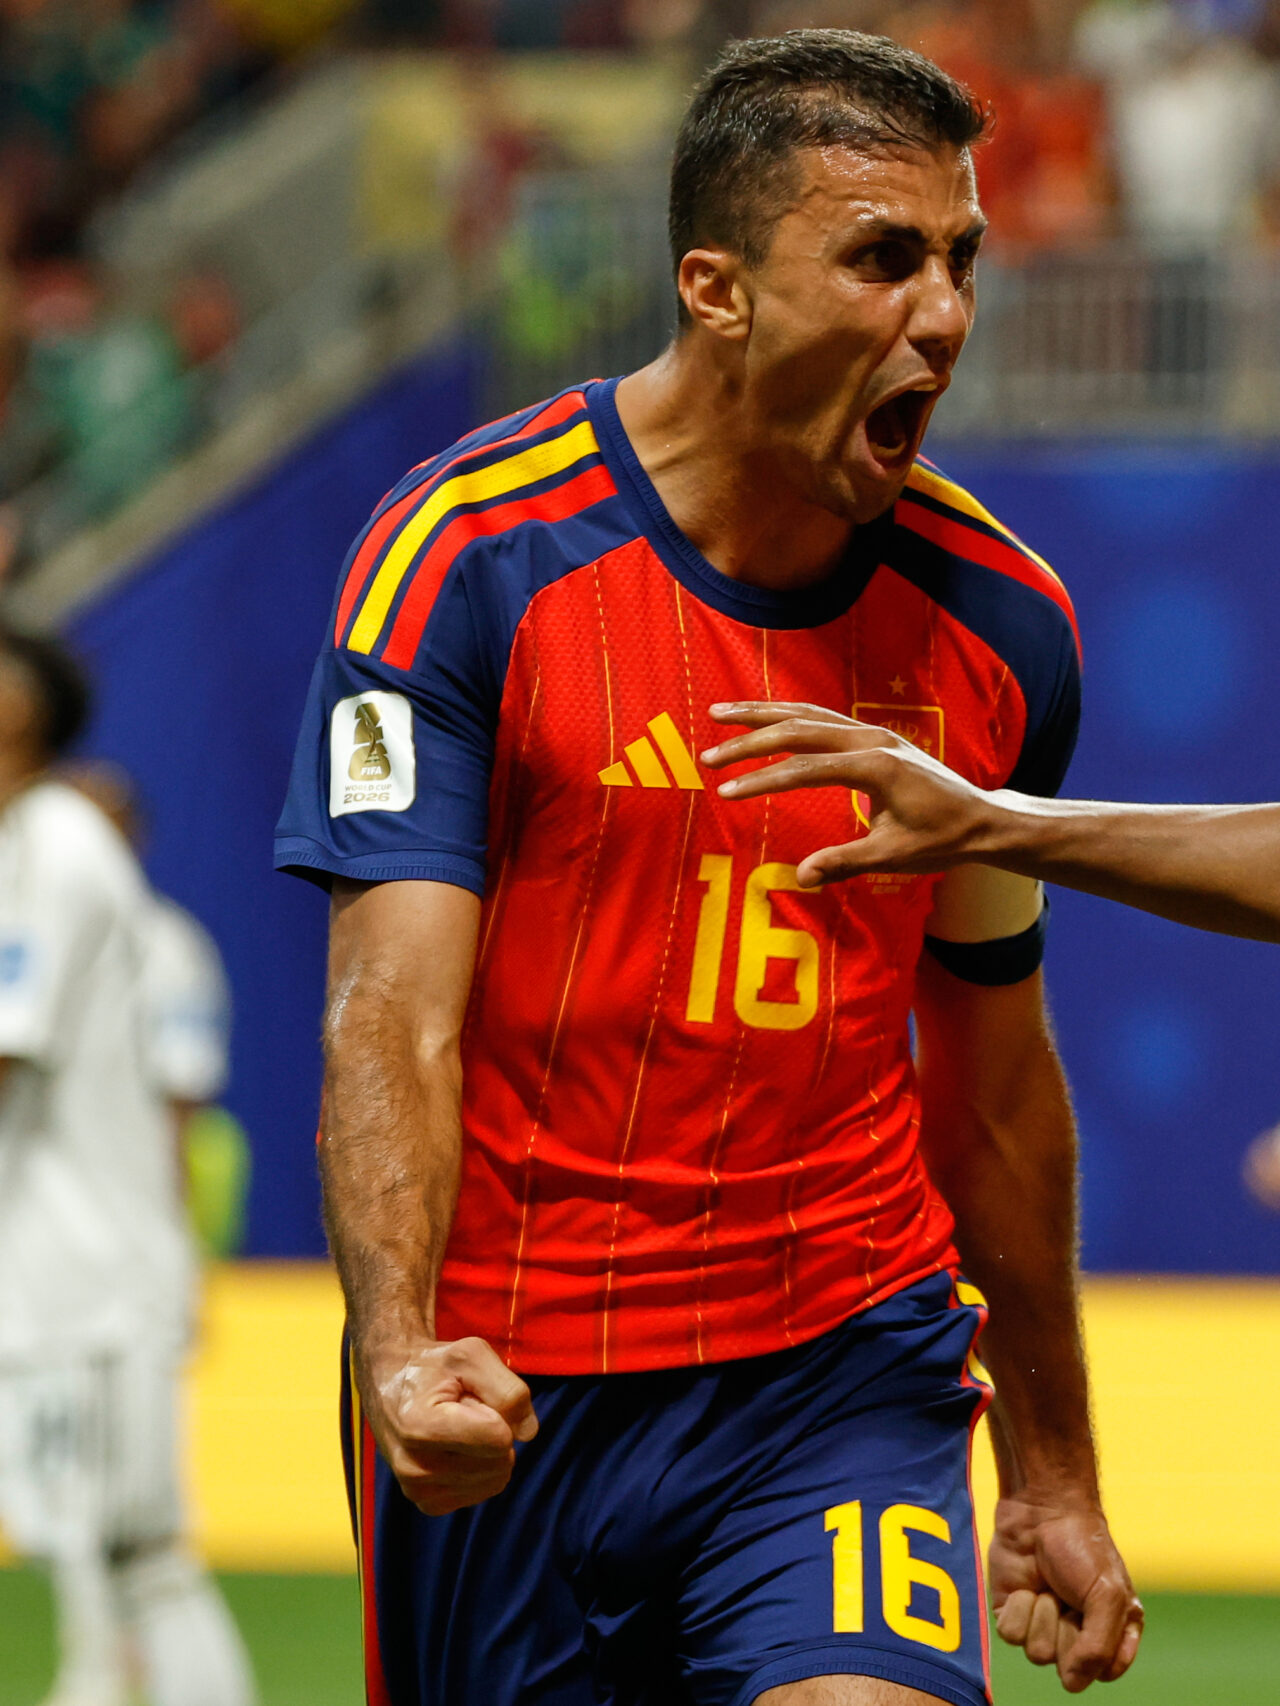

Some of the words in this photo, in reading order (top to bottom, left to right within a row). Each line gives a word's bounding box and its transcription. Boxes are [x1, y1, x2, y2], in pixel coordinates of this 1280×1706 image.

[344, 792, 390, 804] 2026
[361, 766, 382, 776] FIFA
[685, 853, 822, 1031] 16
[824, 1499, 962, 1653] 16
